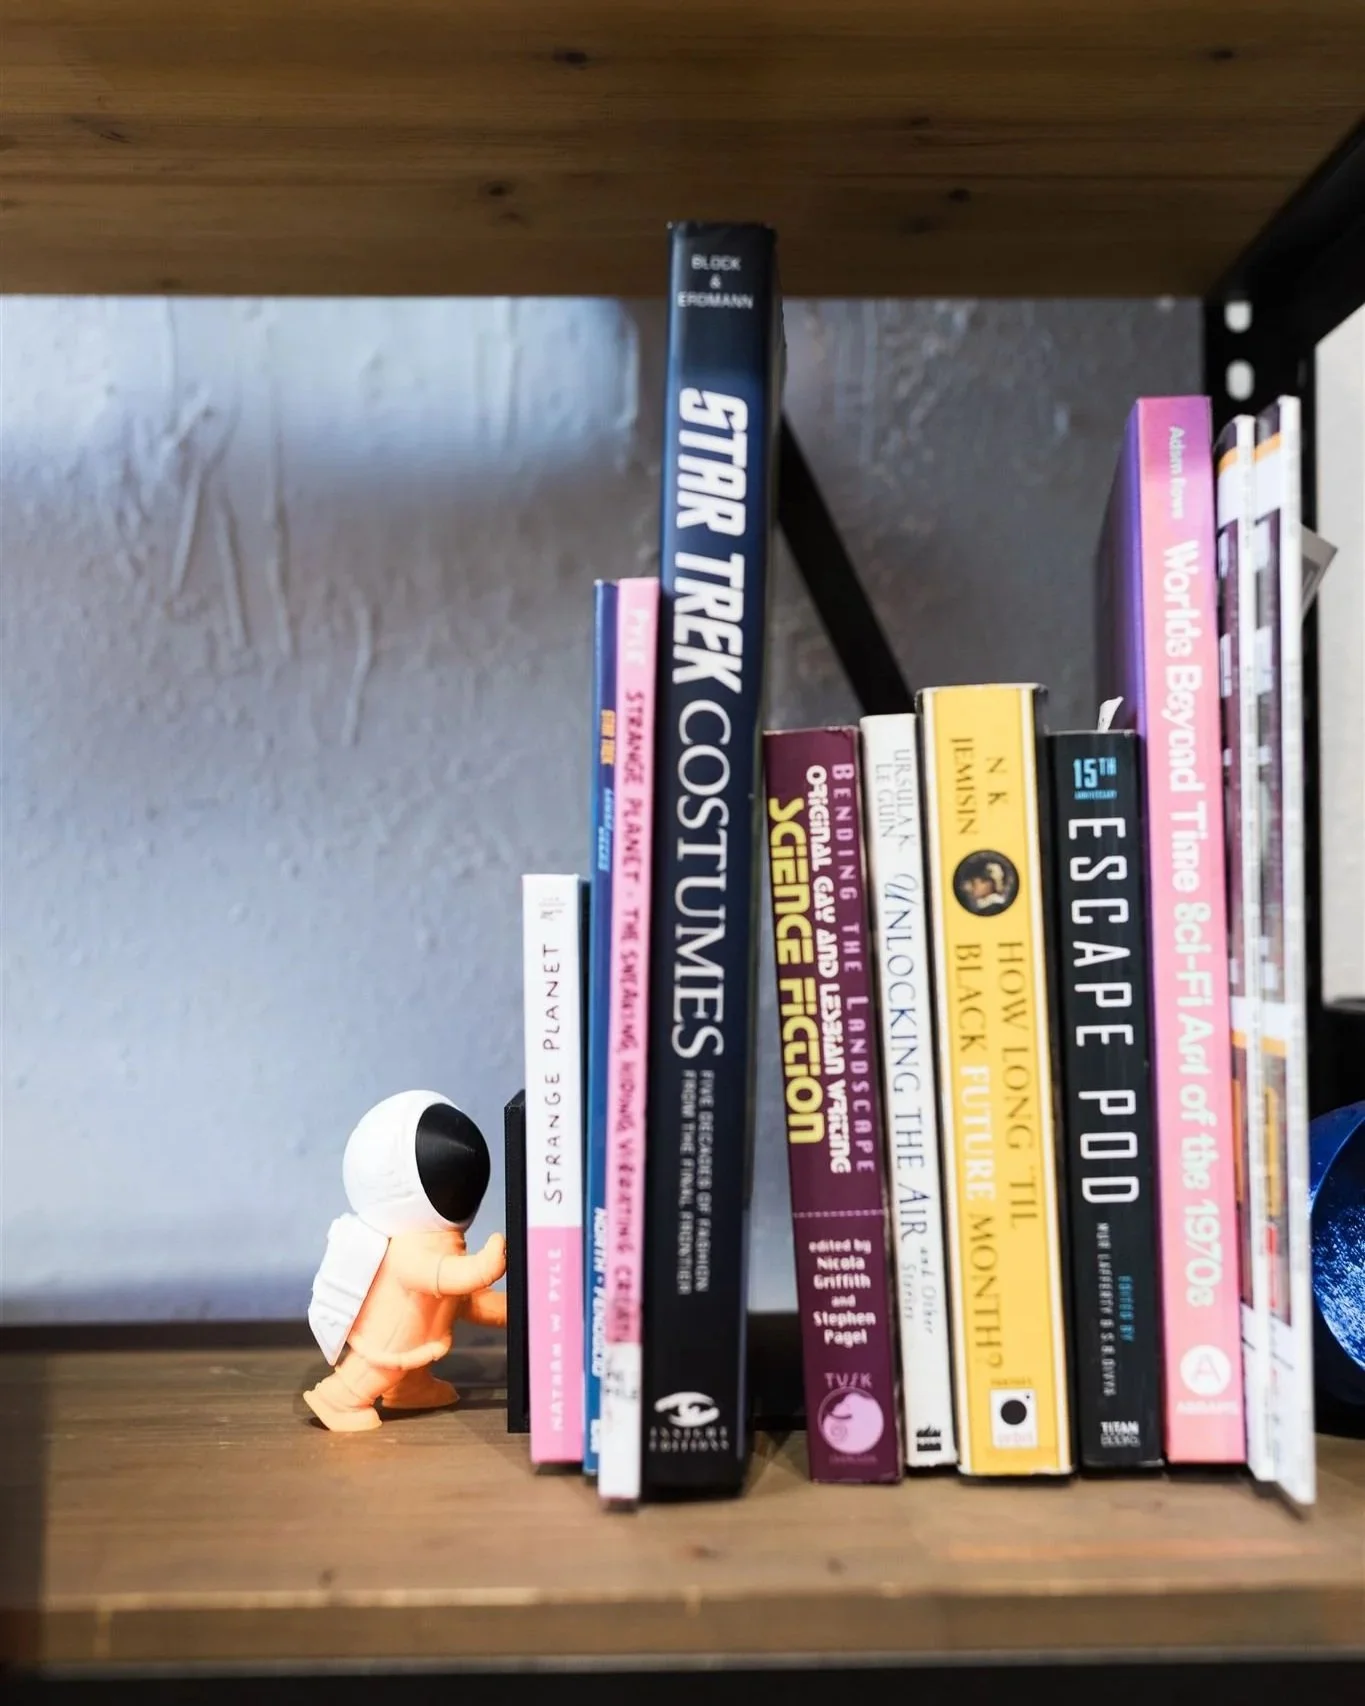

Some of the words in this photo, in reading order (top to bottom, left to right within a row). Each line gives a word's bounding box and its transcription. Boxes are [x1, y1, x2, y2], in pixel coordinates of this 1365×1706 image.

[677, 292, 754, 309] ERDMANN
[692, 255, 741, 271] BLOCK
[710, 275, 722, 288] &
[676, 387, 748, 537] STAR
[673, 552, 746, 694] TREK
[1163, 539, 1202, 657] Worlds
[624, 691, 645, 786] STRANGE
[1161, 665, 1206, 792] Beyond
[879, 786, 897, 839] GUIN
[893, 748, 914, 827] URSULA
[950, 737, 979, 836] JEMISIN
[1073, 757, 1117, 788] 15TH
[622, 797, 644, 883] PLANET
[806, 765, 832, 872] ORIGINAL
[832, 763, 858, 900] BENDING
[1170, 800, 1208, 893] Time
[671, 699, 732, 1059] COSTUMES
[769, 797, 814, 965] SCIENCE
[813, 876, 836, 923] GAY
[621, 908, 639, 941] THE
[816, 929, 839, 978] AND
[842, 922, 862, 972] THE
[1068, 817, 1134, 1047] ESCAPE
[1174, 902, 1213, 1007] Sci-Fi
[543, 943, 560, 1051] PLANET
[885, 873, 921, 1093] UNLOCKING
[955, 943, 987, 1053] BLACK
[997, 941, 1029, 1031] HOW
[779, 977, 825, 1144] FICTION
[819, 983, 845, 1075] LESBIAN
[1177, 1013, 1214, 1075] Art
[681, 1069, 697, 1119] FROM
[698, 1069, 715, 1108] FIVE
[847, 996, 875, 1173] LANDSCAPE
[1002, 1046, 1034, 1150] LONG
[1179, 1084, 1217, 1126] of
[544, 1073, 562, 1205] STRANGE
[679, 1122, 696, 1156] THE
[696, 1110, 714, 1190] DECADES
[827, 1079, 851, 1174] WRITING
[894, 1107, 924, 1170] THE
[959, 1064, 995, 1200] FUTURE
[1078, 1089, 1140, 1204] POD
[1181, 1132, 1219, 1190] the
[678, 1157, 696, 1209] FINAL
[695, 1191, 713, 1216] OF
[897, 1183, 930, 1242] AIR
[547, 1247, 564, 1303] PYLE
[676, 1210, 694, 1295] FRONTIER
[694, 1217, 712, 1293] FASHION
[808, 1239, 851, 1253] edited
[853, 1239, 872, 1254] by
[812, 1274, 871, 1290] Griffith
[816, 1255, 866, 1271] Nicola
[1184, 1198, 1223, 1308] 1970s
[550, 1314, 562, 1333] W
[812, 1311, 876, 1327] Stephen
[831, 1294, 856, 1308] and
[967, 1212, 1005, 1370] MONTH?
[824, 1328, 867, 1348] Pagel
[549, 1342, 564, 1432] NATHAN
[1100, 1420, 1139, 1435] TITAN
